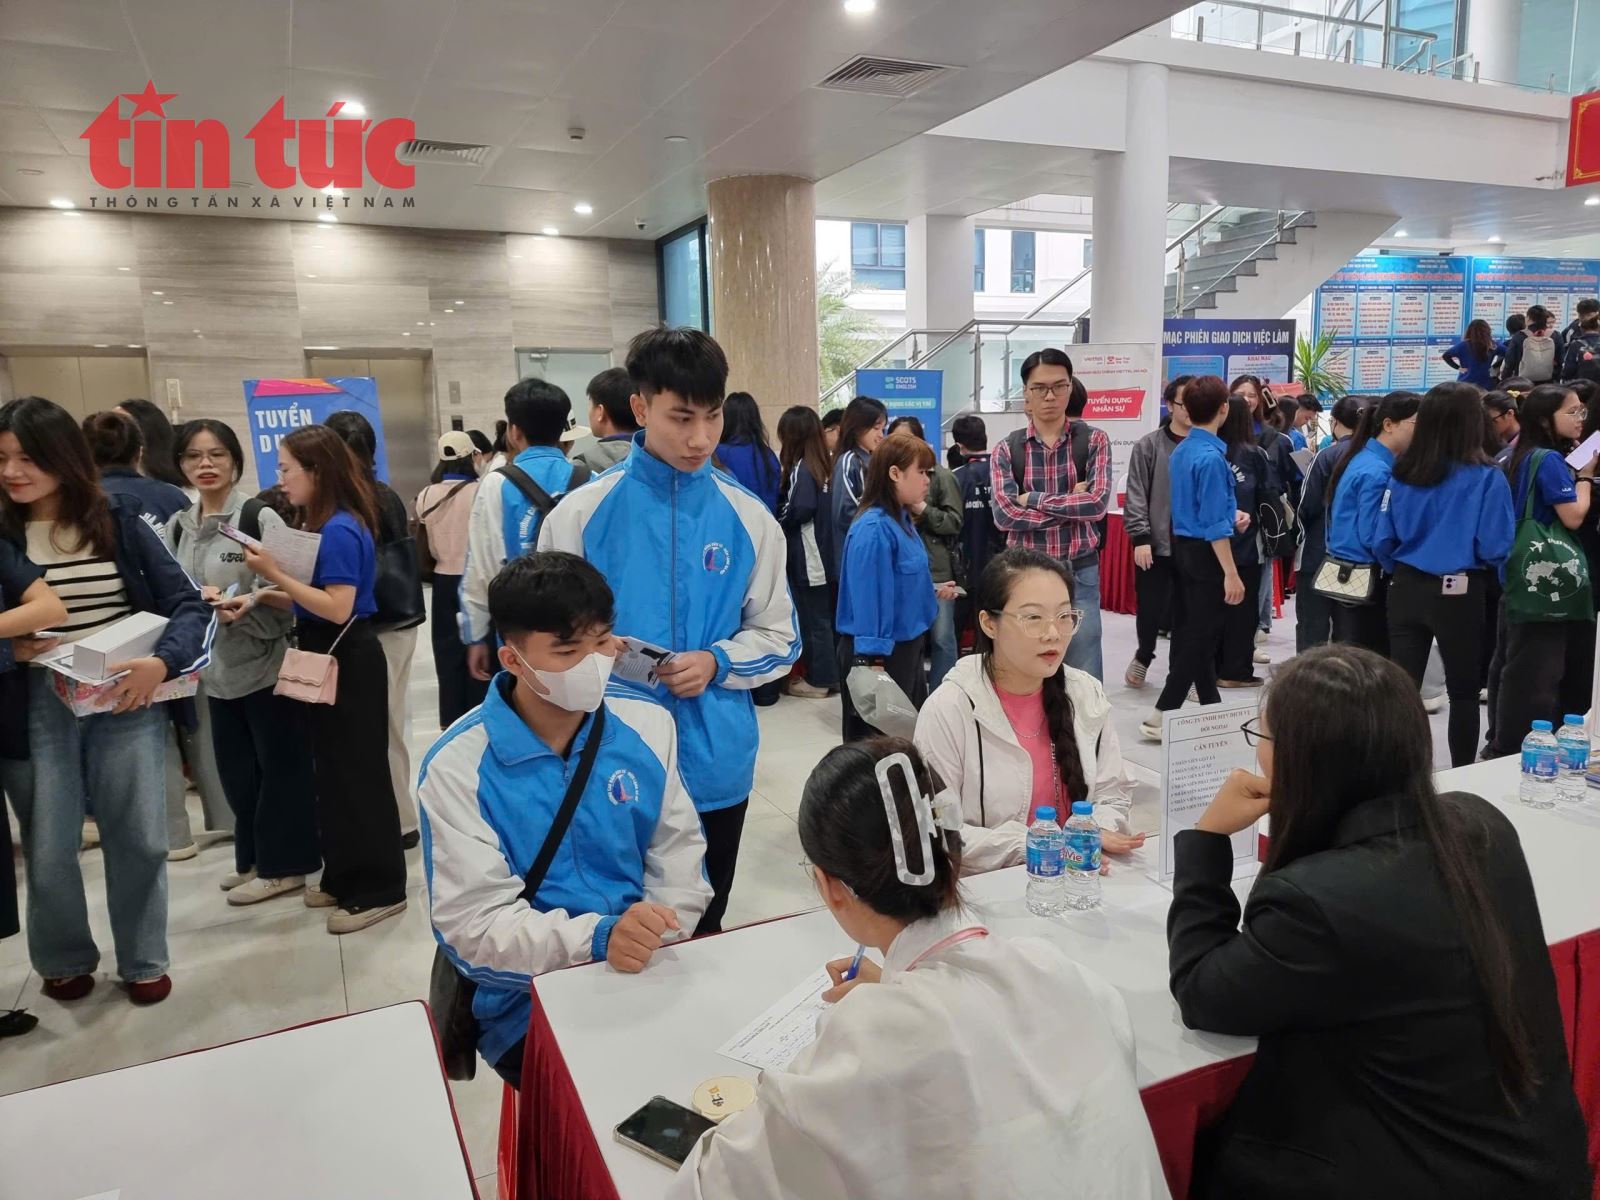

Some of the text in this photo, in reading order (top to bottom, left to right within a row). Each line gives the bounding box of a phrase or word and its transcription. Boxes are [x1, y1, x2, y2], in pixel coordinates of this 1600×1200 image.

[1163, 328, 1290, 347] MẠC PHIÊN GIAO DỊCH VIỆC LÀM
[1087, 395, 1132, 405] TUYỂN DỤNG
[255, 402, 313, 429] TUYỂN
[1092, 404, 1125, 413] NHÂN SỰ
